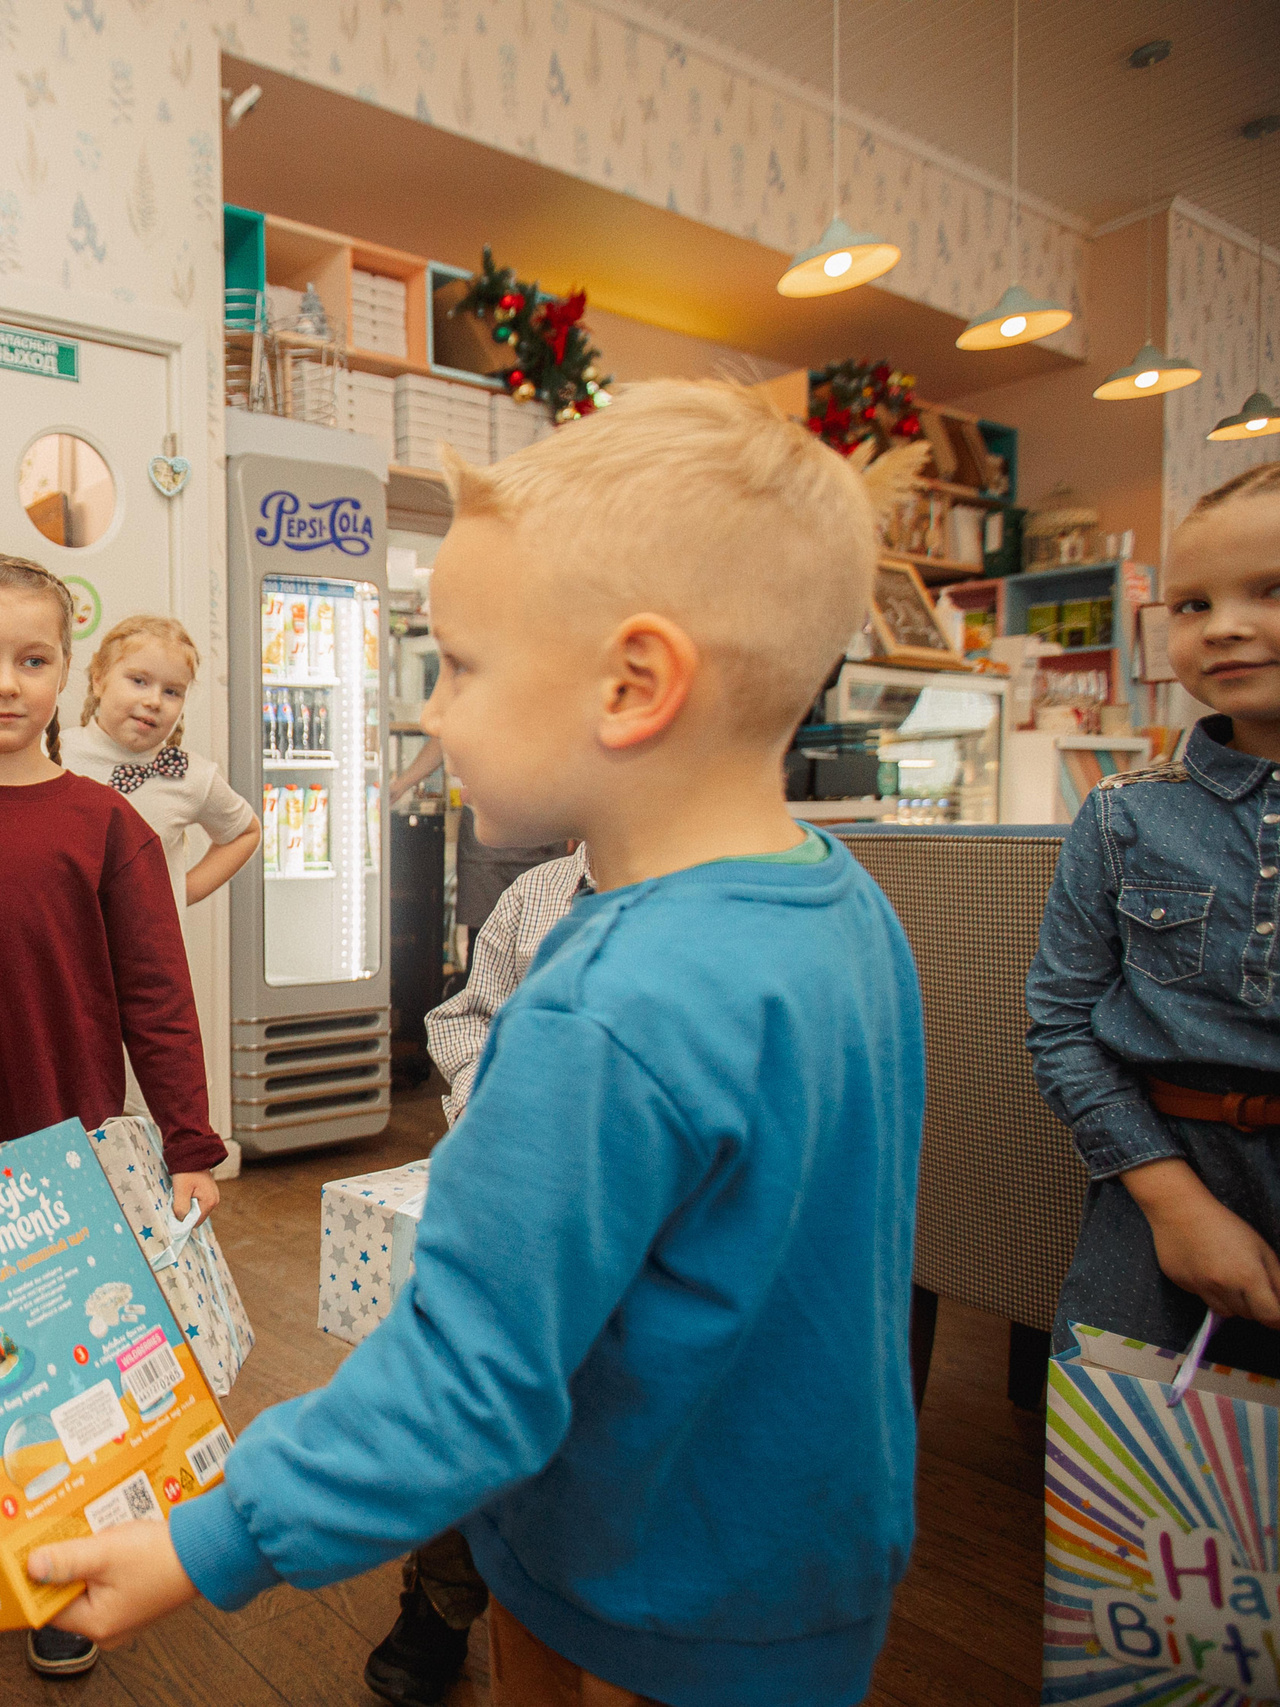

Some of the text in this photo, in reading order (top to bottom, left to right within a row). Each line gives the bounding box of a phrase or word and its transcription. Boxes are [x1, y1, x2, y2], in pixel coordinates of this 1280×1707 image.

[120, 1333, 163, 1368] WILDBERRIES
[164, 1481, 180, 1500] 14+
[1159, 1531, 1280, 1620] Ha
